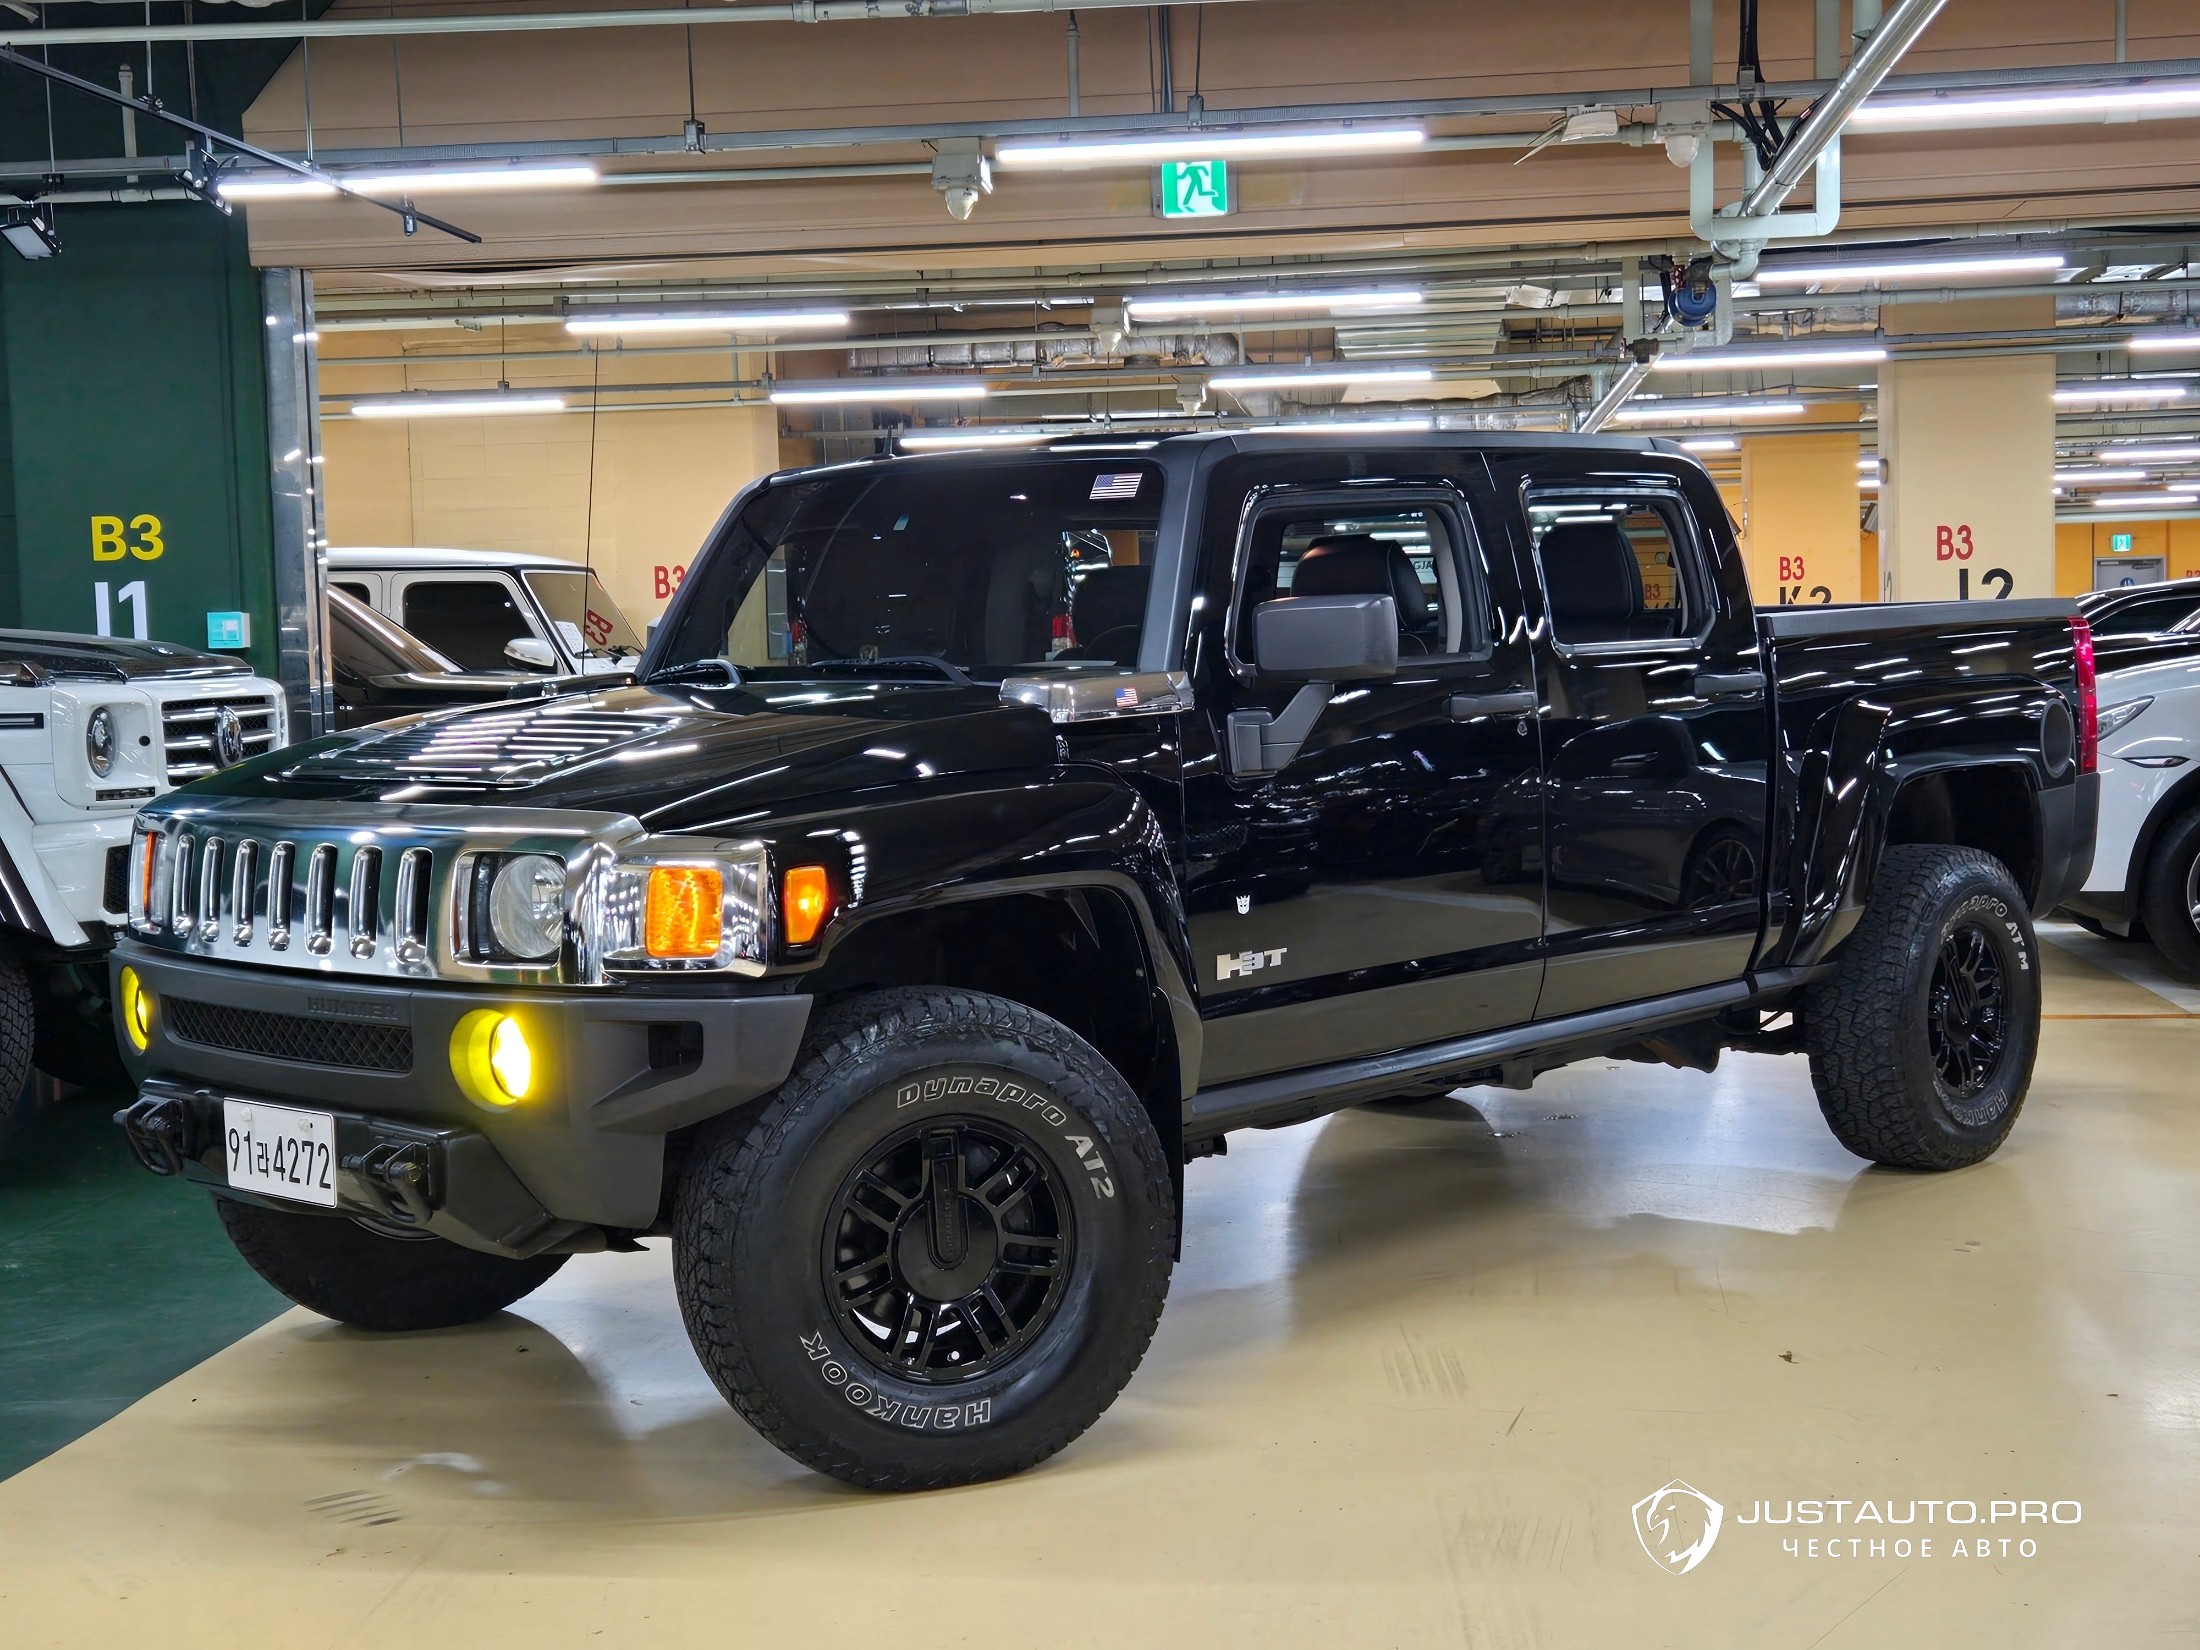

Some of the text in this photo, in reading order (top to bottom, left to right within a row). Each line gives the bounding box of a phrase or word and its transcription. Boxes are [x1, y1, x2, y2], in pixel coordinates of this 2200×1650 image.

[91, 513, 165, 562] B3
[1936, 524, 1974, 561] B3
[1779, 555, 1805, 581] B3
[1216, 947, 1288, 981] H3T
[228, 1127, 332, 1190] 91라4272
[1064, 1135, 1115, 1200] AT2
